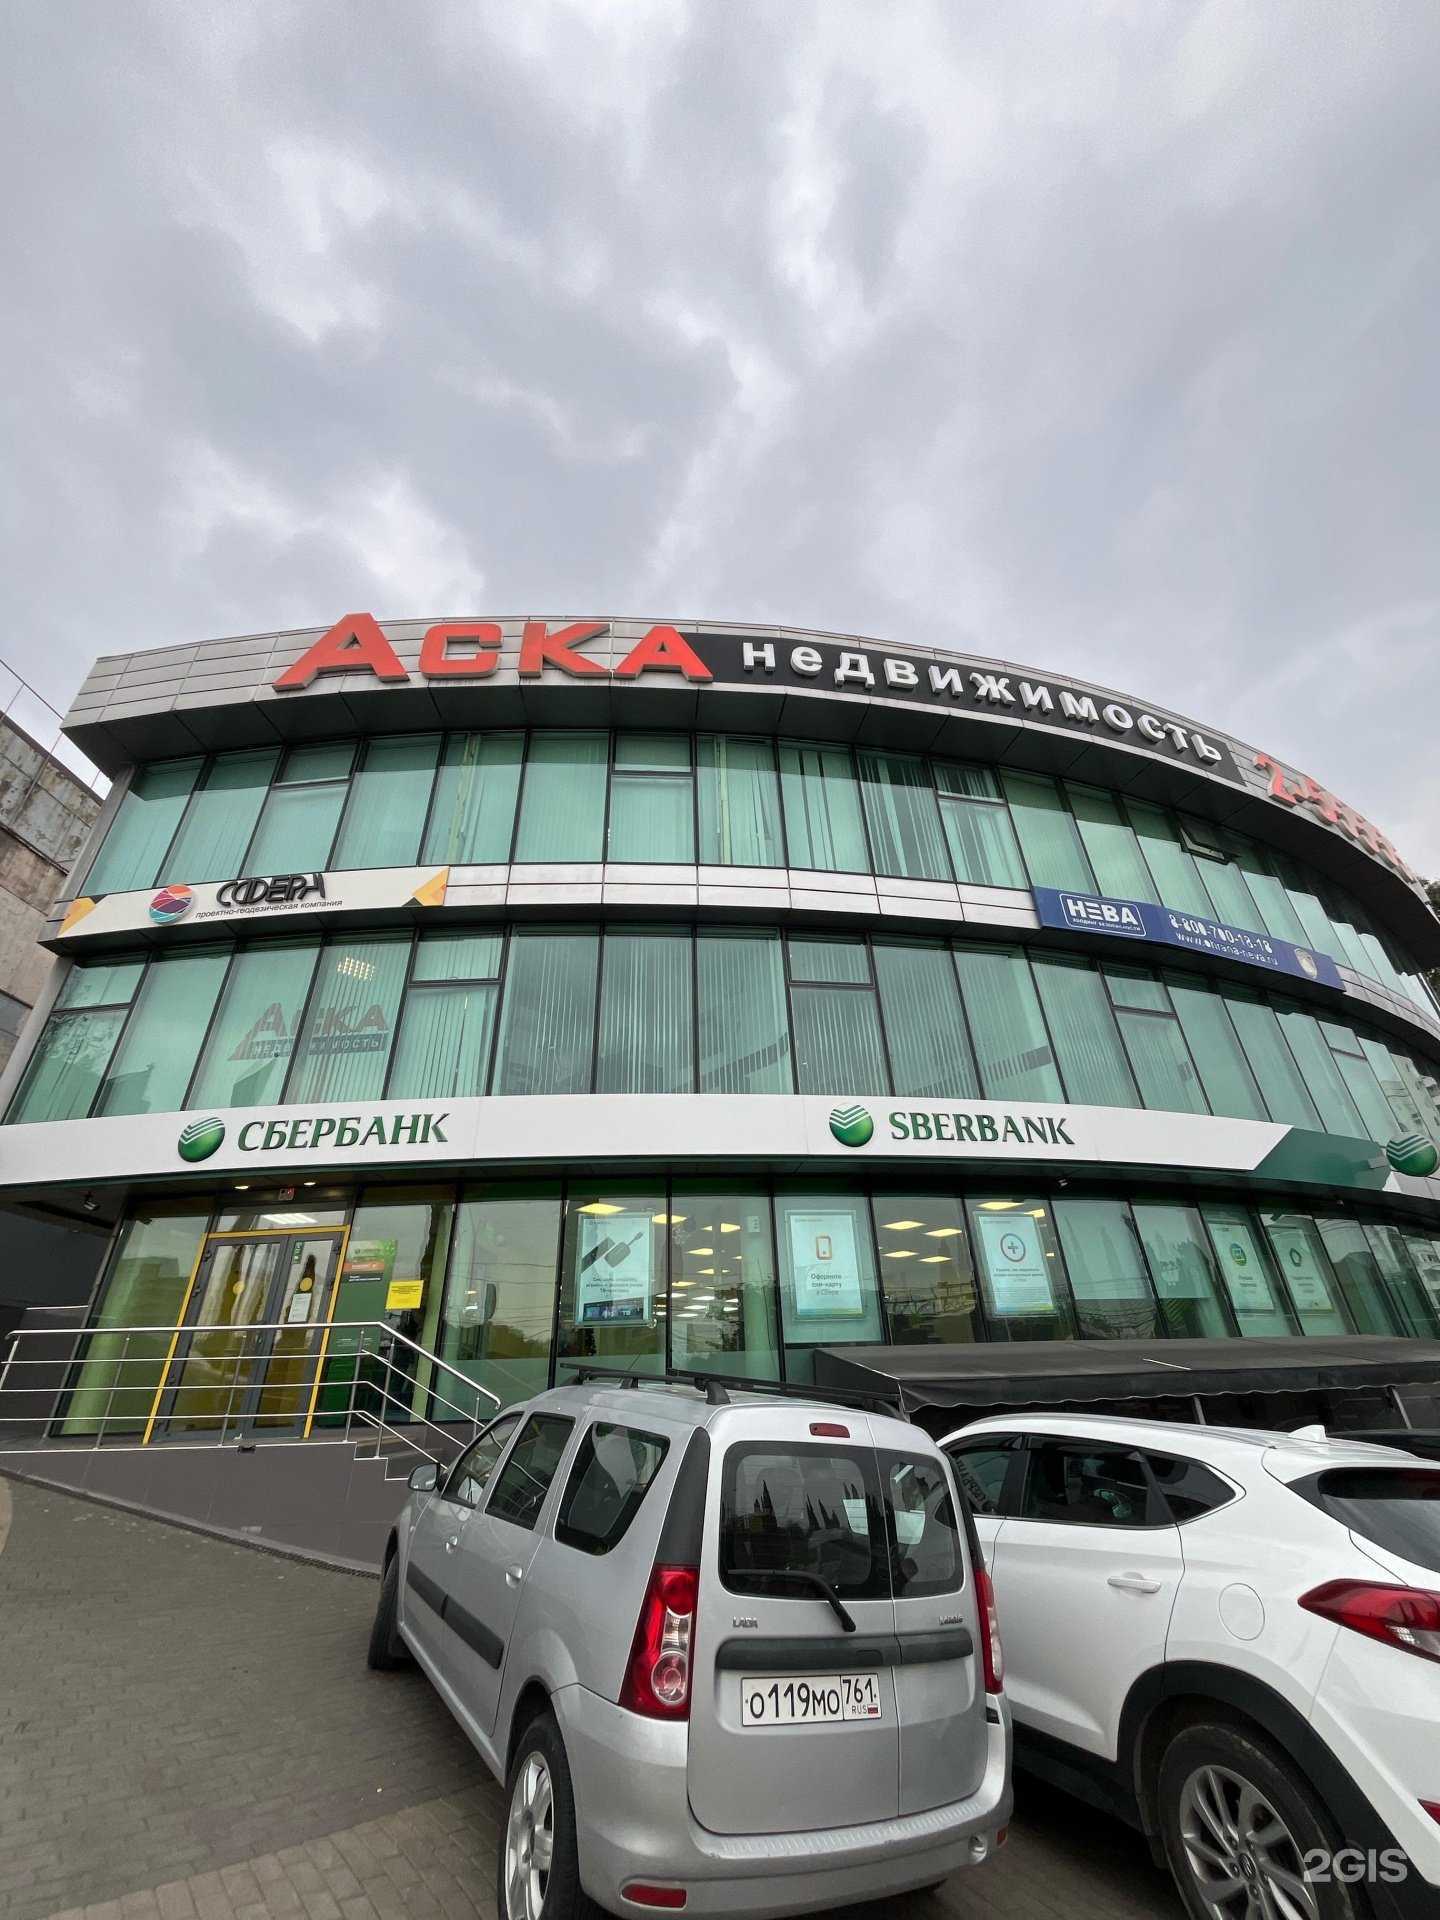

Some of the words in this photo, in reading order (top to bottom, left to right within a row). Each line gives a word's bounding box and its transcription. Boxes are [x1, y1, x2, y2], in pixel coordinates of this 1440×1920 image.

[272, 612, 714, 691] АСКА
[216, 872, 326, 907] СФЕРА
[195, 902, 299, 919] проектно-геодезическая
[300, 899, 343, 909] компания
[1066, 898, 1139, 926] НЕВА
[237, 1112, 450, 1152] СБЕРБАНК
[888, 1111, 1075, 1145] SBERBANK
[842, 1678, 873, 1704] 761
[852, 1705, 867, 1714] RUS
